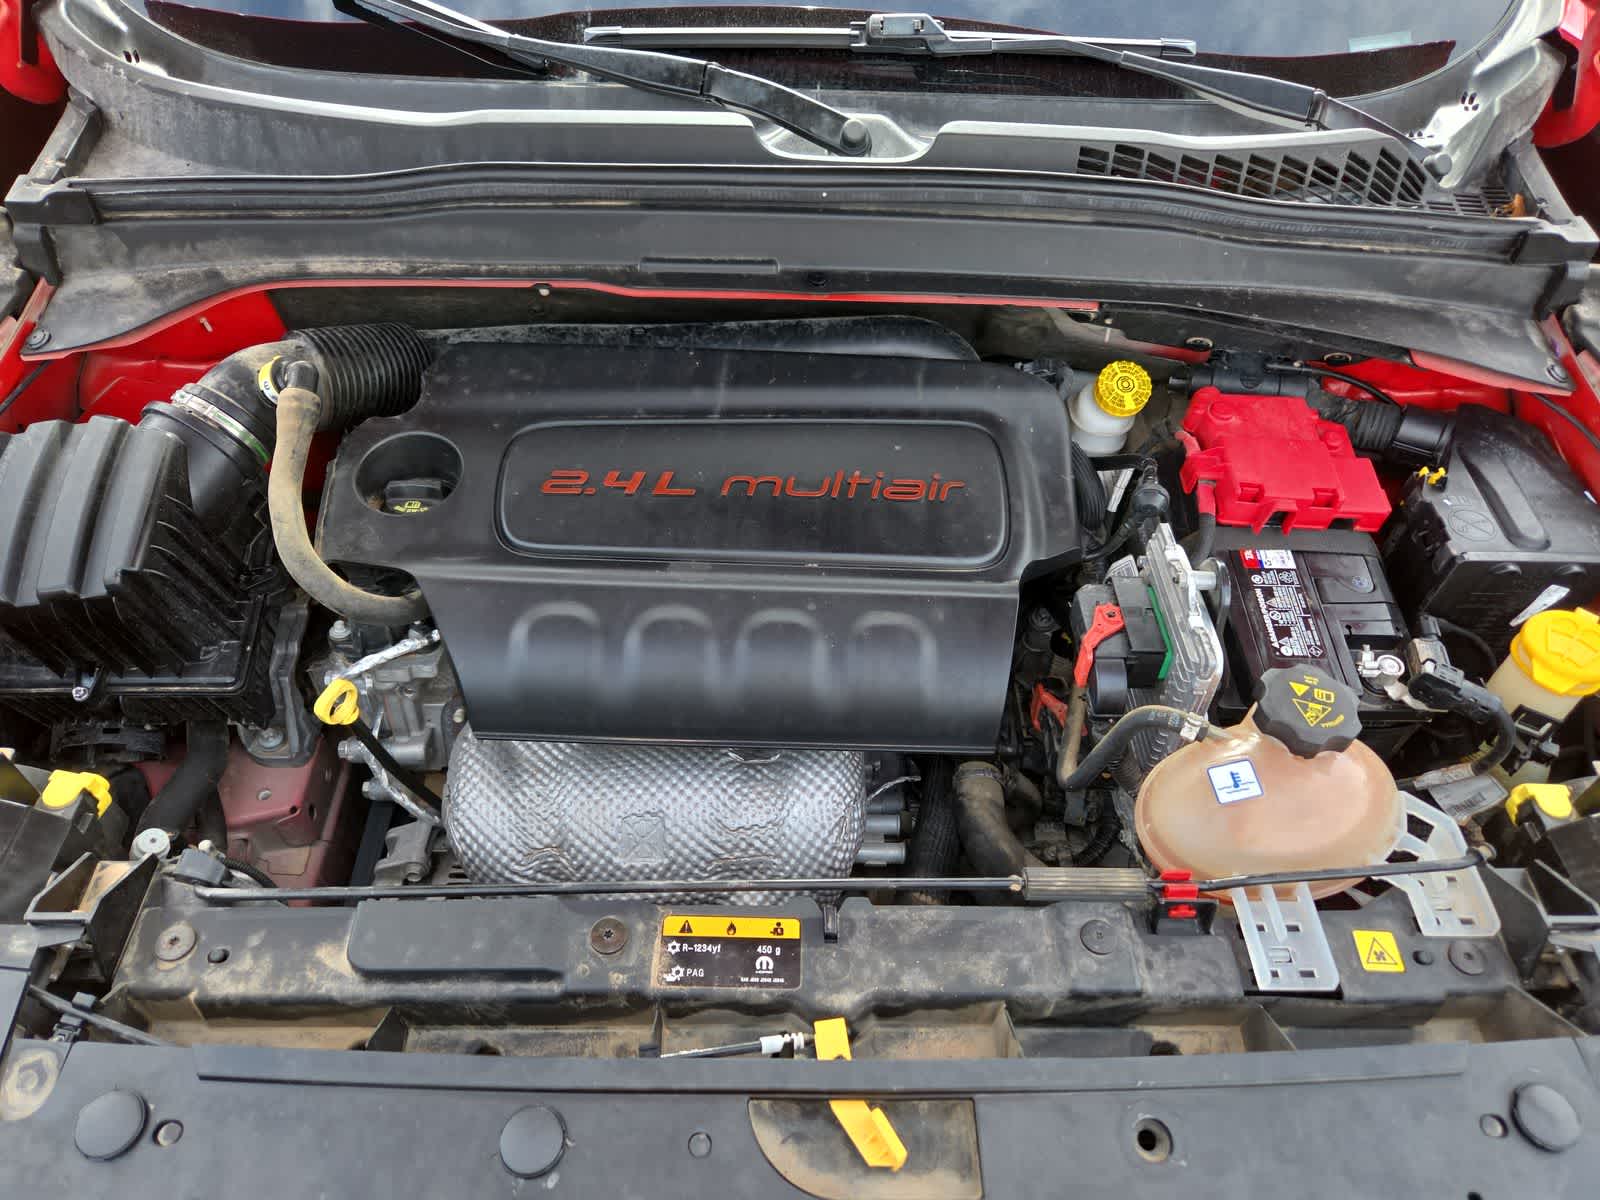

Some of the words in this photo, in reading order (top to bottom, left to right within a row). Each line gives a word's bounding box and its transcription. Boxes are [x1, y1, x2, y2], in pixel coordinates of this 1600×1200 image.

[720, 469, 966, 501] multiair
[682, 943, 721, 954] R-1234yf
[756, 945, 772, 954] 450
[775, 946, 781, 956] g
[686, 968, 705, 978] PAG
